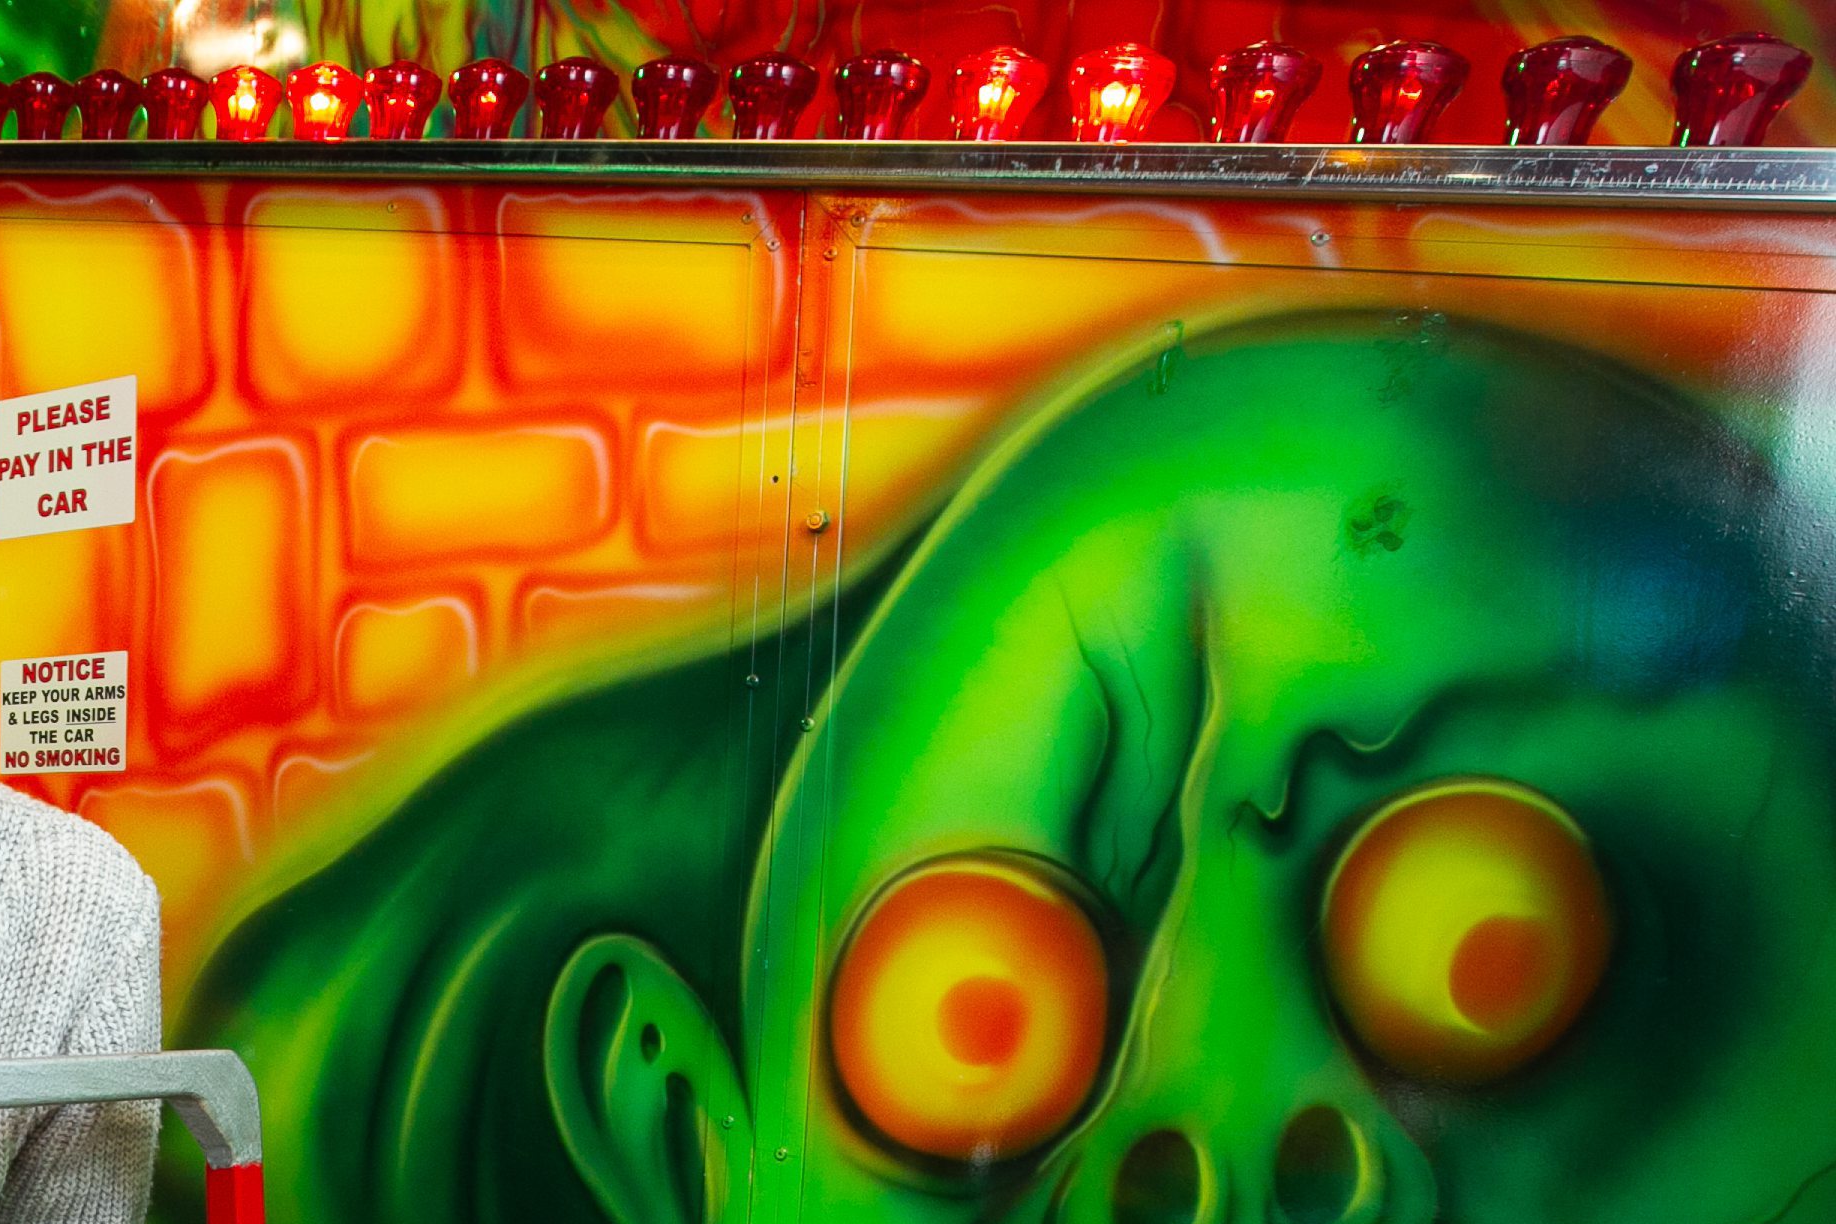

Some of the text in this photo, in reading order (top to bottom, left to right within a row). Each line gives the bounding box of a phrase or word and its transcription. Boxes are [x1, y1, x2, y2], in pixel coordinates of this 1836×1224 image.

[17, 395, 110, 436] PLEASE
[48, 446, 73, 473] IN
[81, 435, 132, 467] THE
[37, 488, 88, 518] CAR
[22, 657, 105, 685] NOTICE
[2, 685, 125, 706] KEEP YOUR ARMS
[8, 707, 116, 726] & LEGS INSIDE
[29, 728, 94, 744] THE CAR
[5, 747, 120, 769] NO SMOKING
